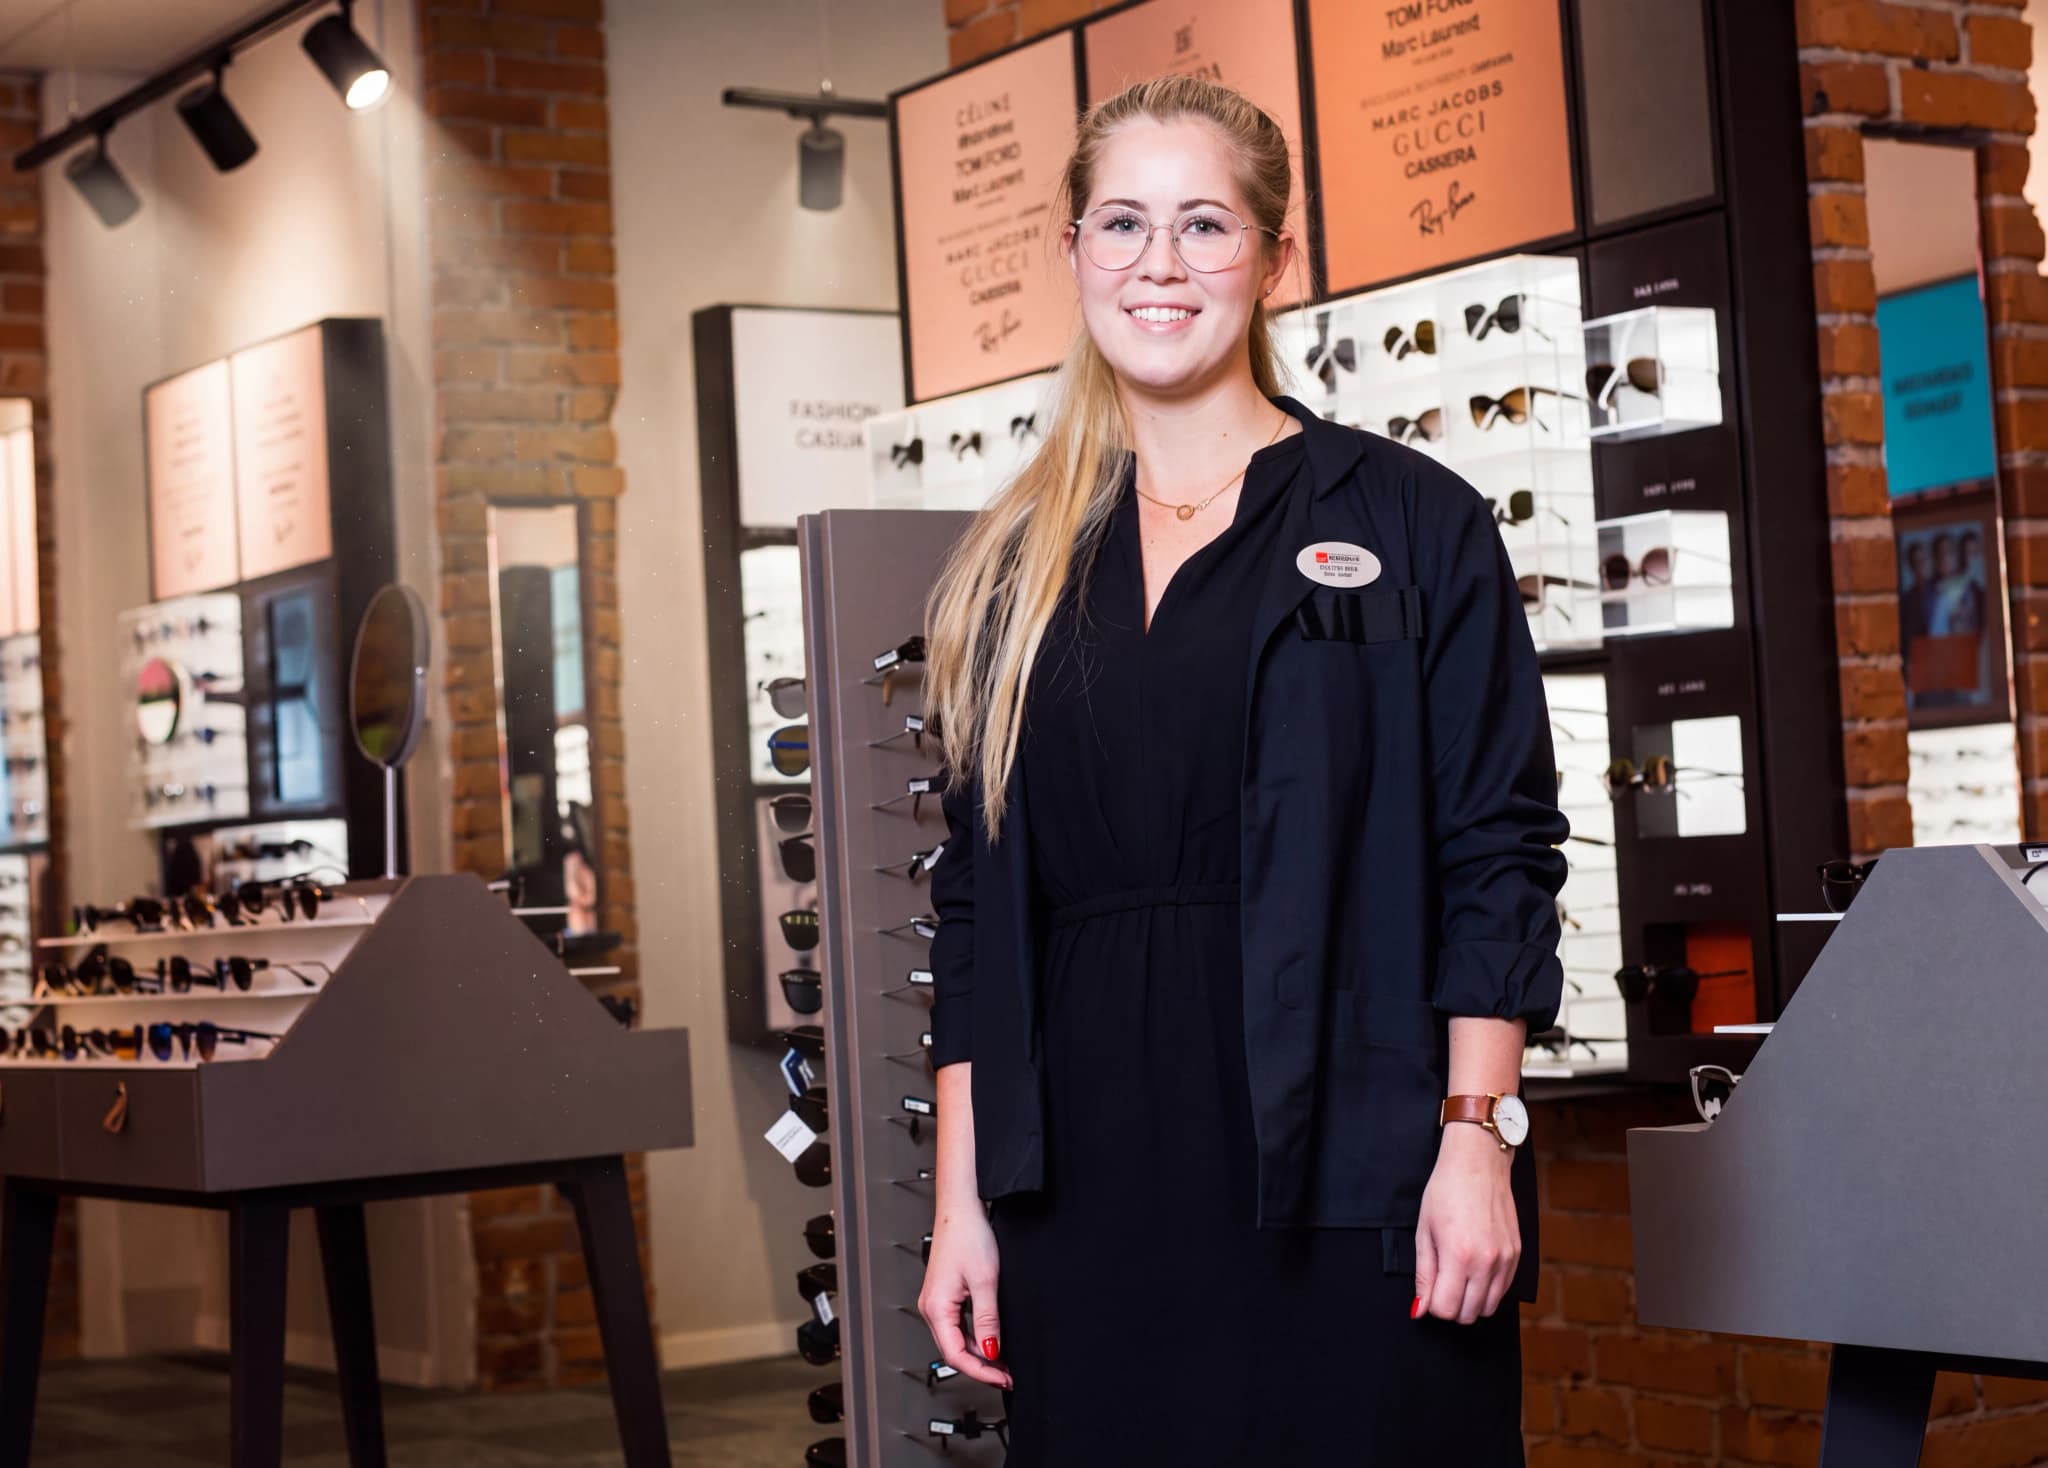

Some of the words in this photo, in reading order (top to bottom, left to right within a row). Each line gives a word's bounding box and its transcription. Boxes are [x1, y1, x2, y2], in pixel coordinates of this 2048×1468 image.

[1386, 1, 1423, 29] TOM
[1427, 0, 1474, 16] FOR
[1382, 36, 1417, 61] Marc
[1372, 105, 1420, 131] MARC
[1428, 79, 1503, 117] JACOBS
[1393, 110, 1485, 157] GUCCI
[960, 249, 1029, 288] GUCCI
[789, 399, 882, 422] FASHION
[794, 427, 864, 450] CASUA
